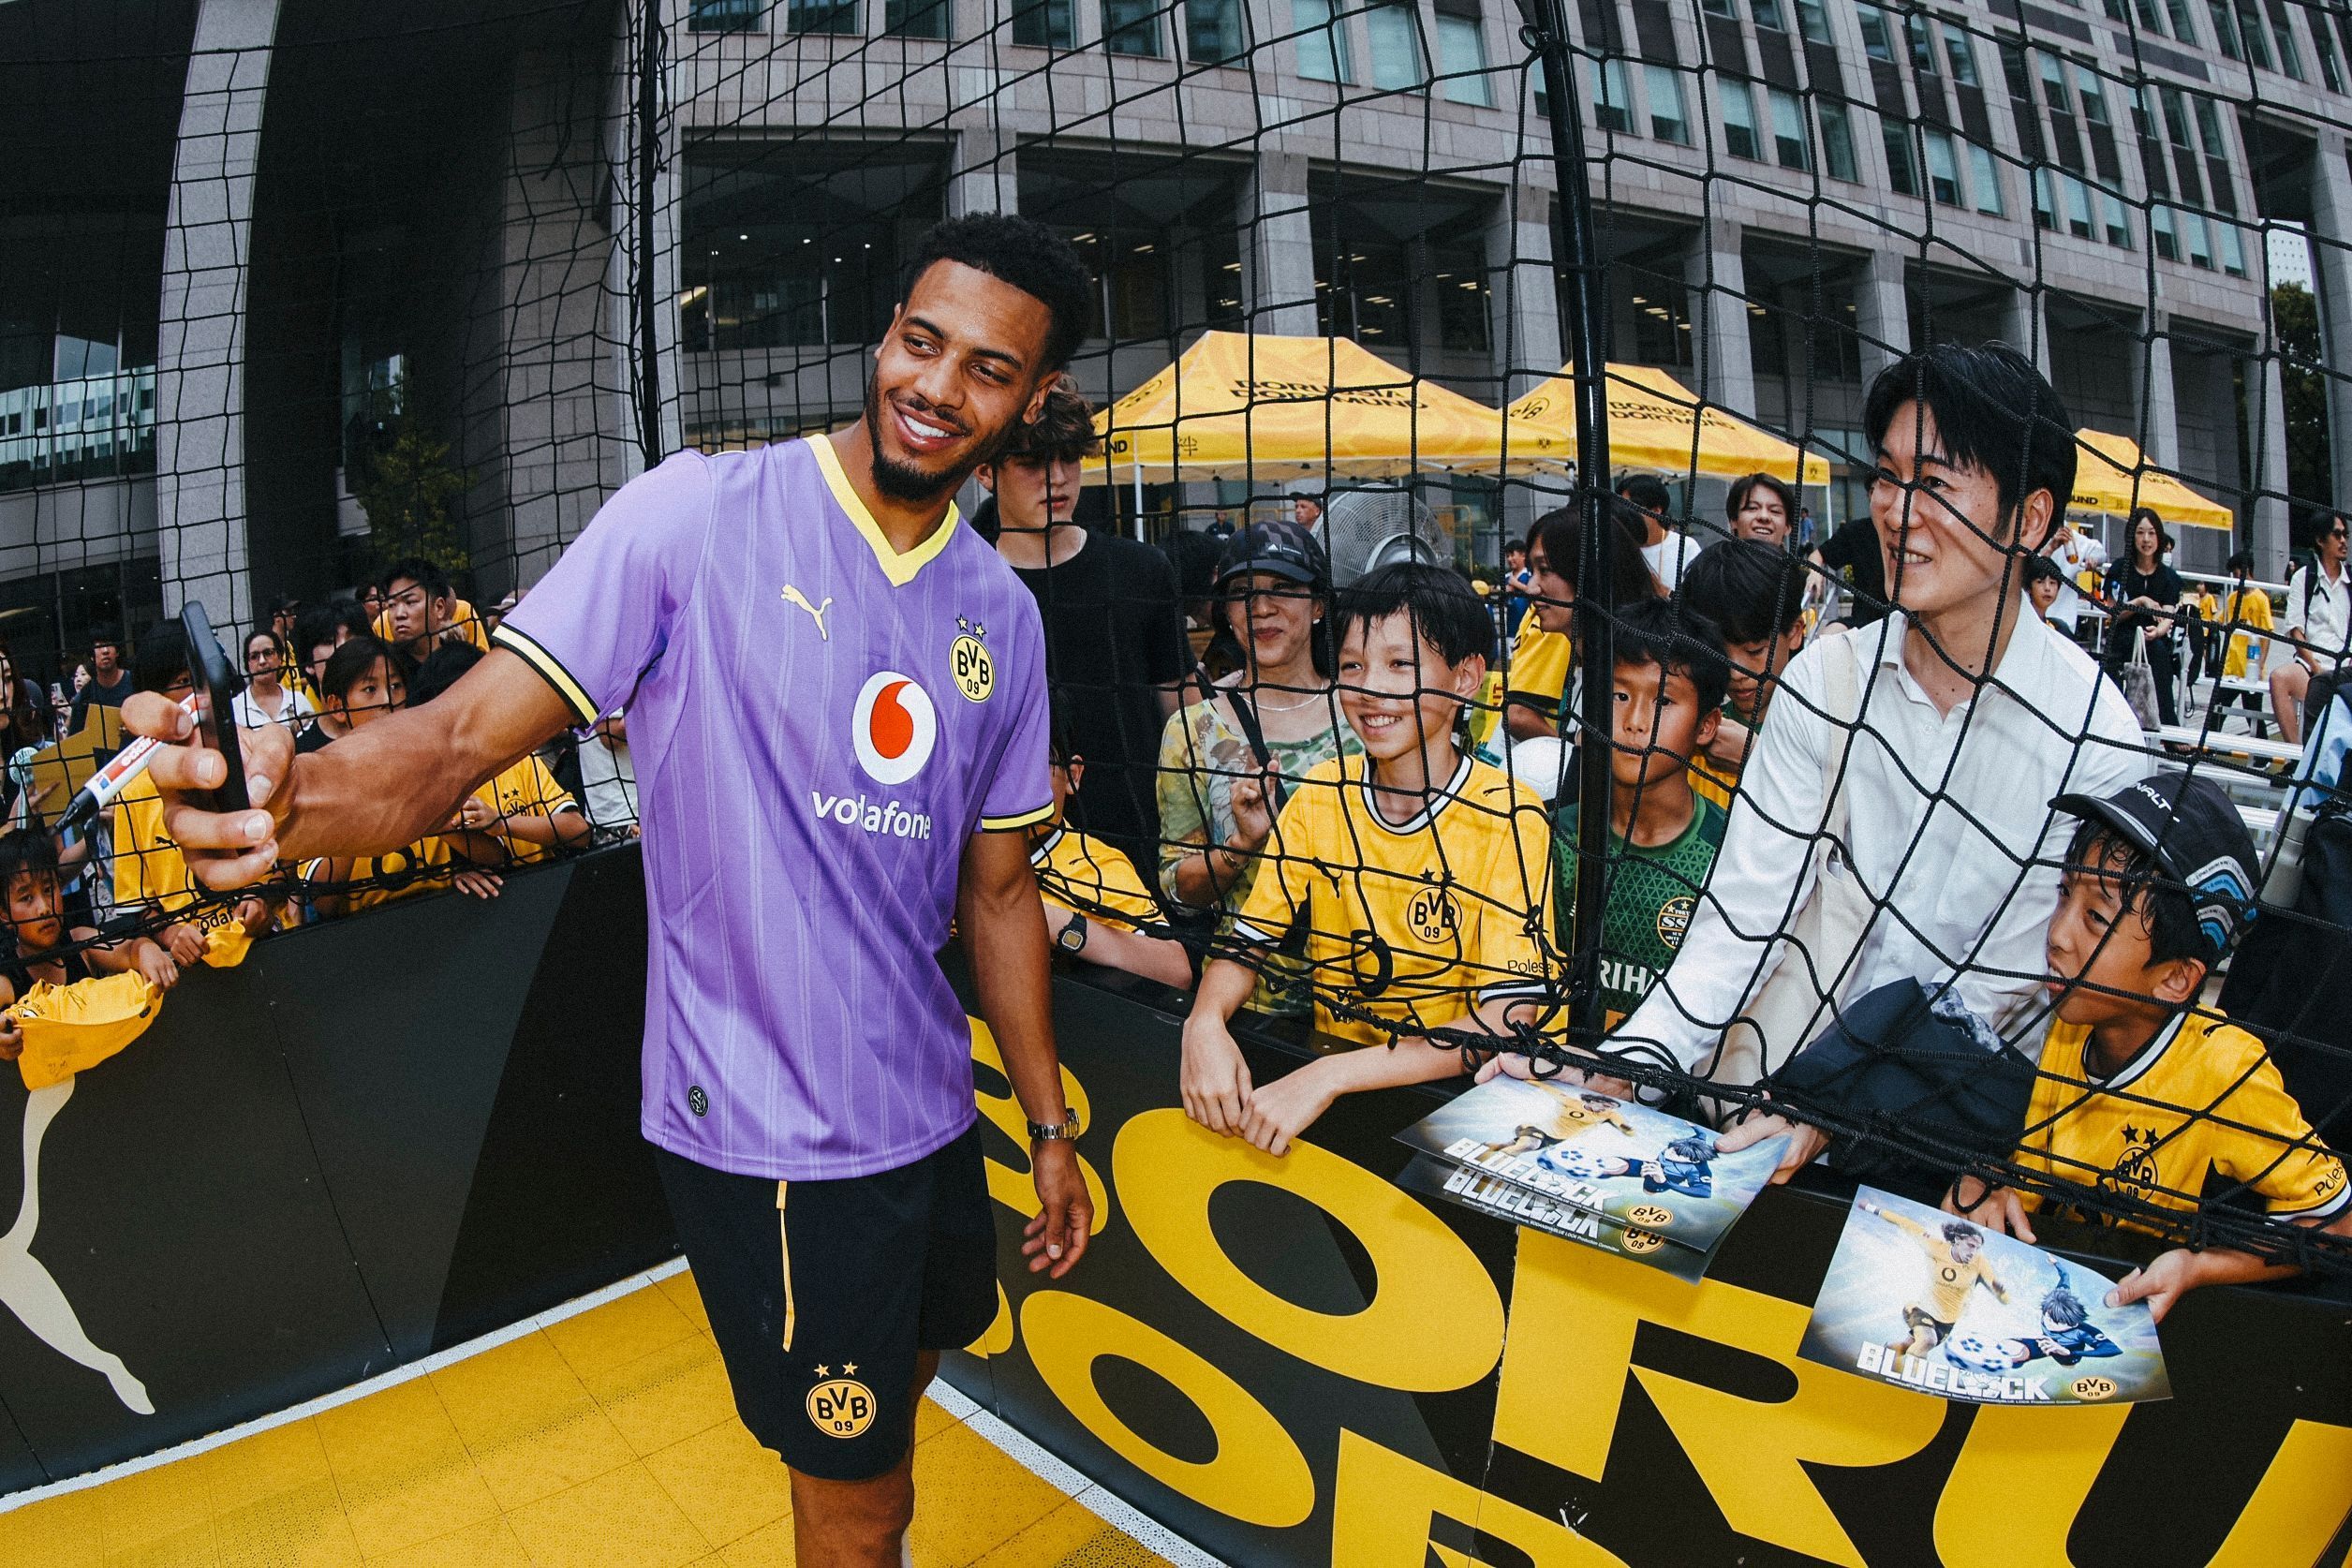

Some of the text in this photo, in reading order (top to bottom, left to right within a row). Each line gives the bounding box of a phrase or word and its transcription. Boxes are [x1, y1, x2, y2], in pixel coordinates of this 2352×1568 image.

[957, 641, 989, 685] BVB
[968, 678, 979, 694] 09
[1424, 926, 1441, 938] 09
[1633, 1206, 1667, 1222] BVB
[1632, 1239, 1645, 1250] 09
[2077, 1379, 2111, 1393] BVB
[816, 1386, 868, 1420] BVB
[824, 1420, 854, 1432] 09
